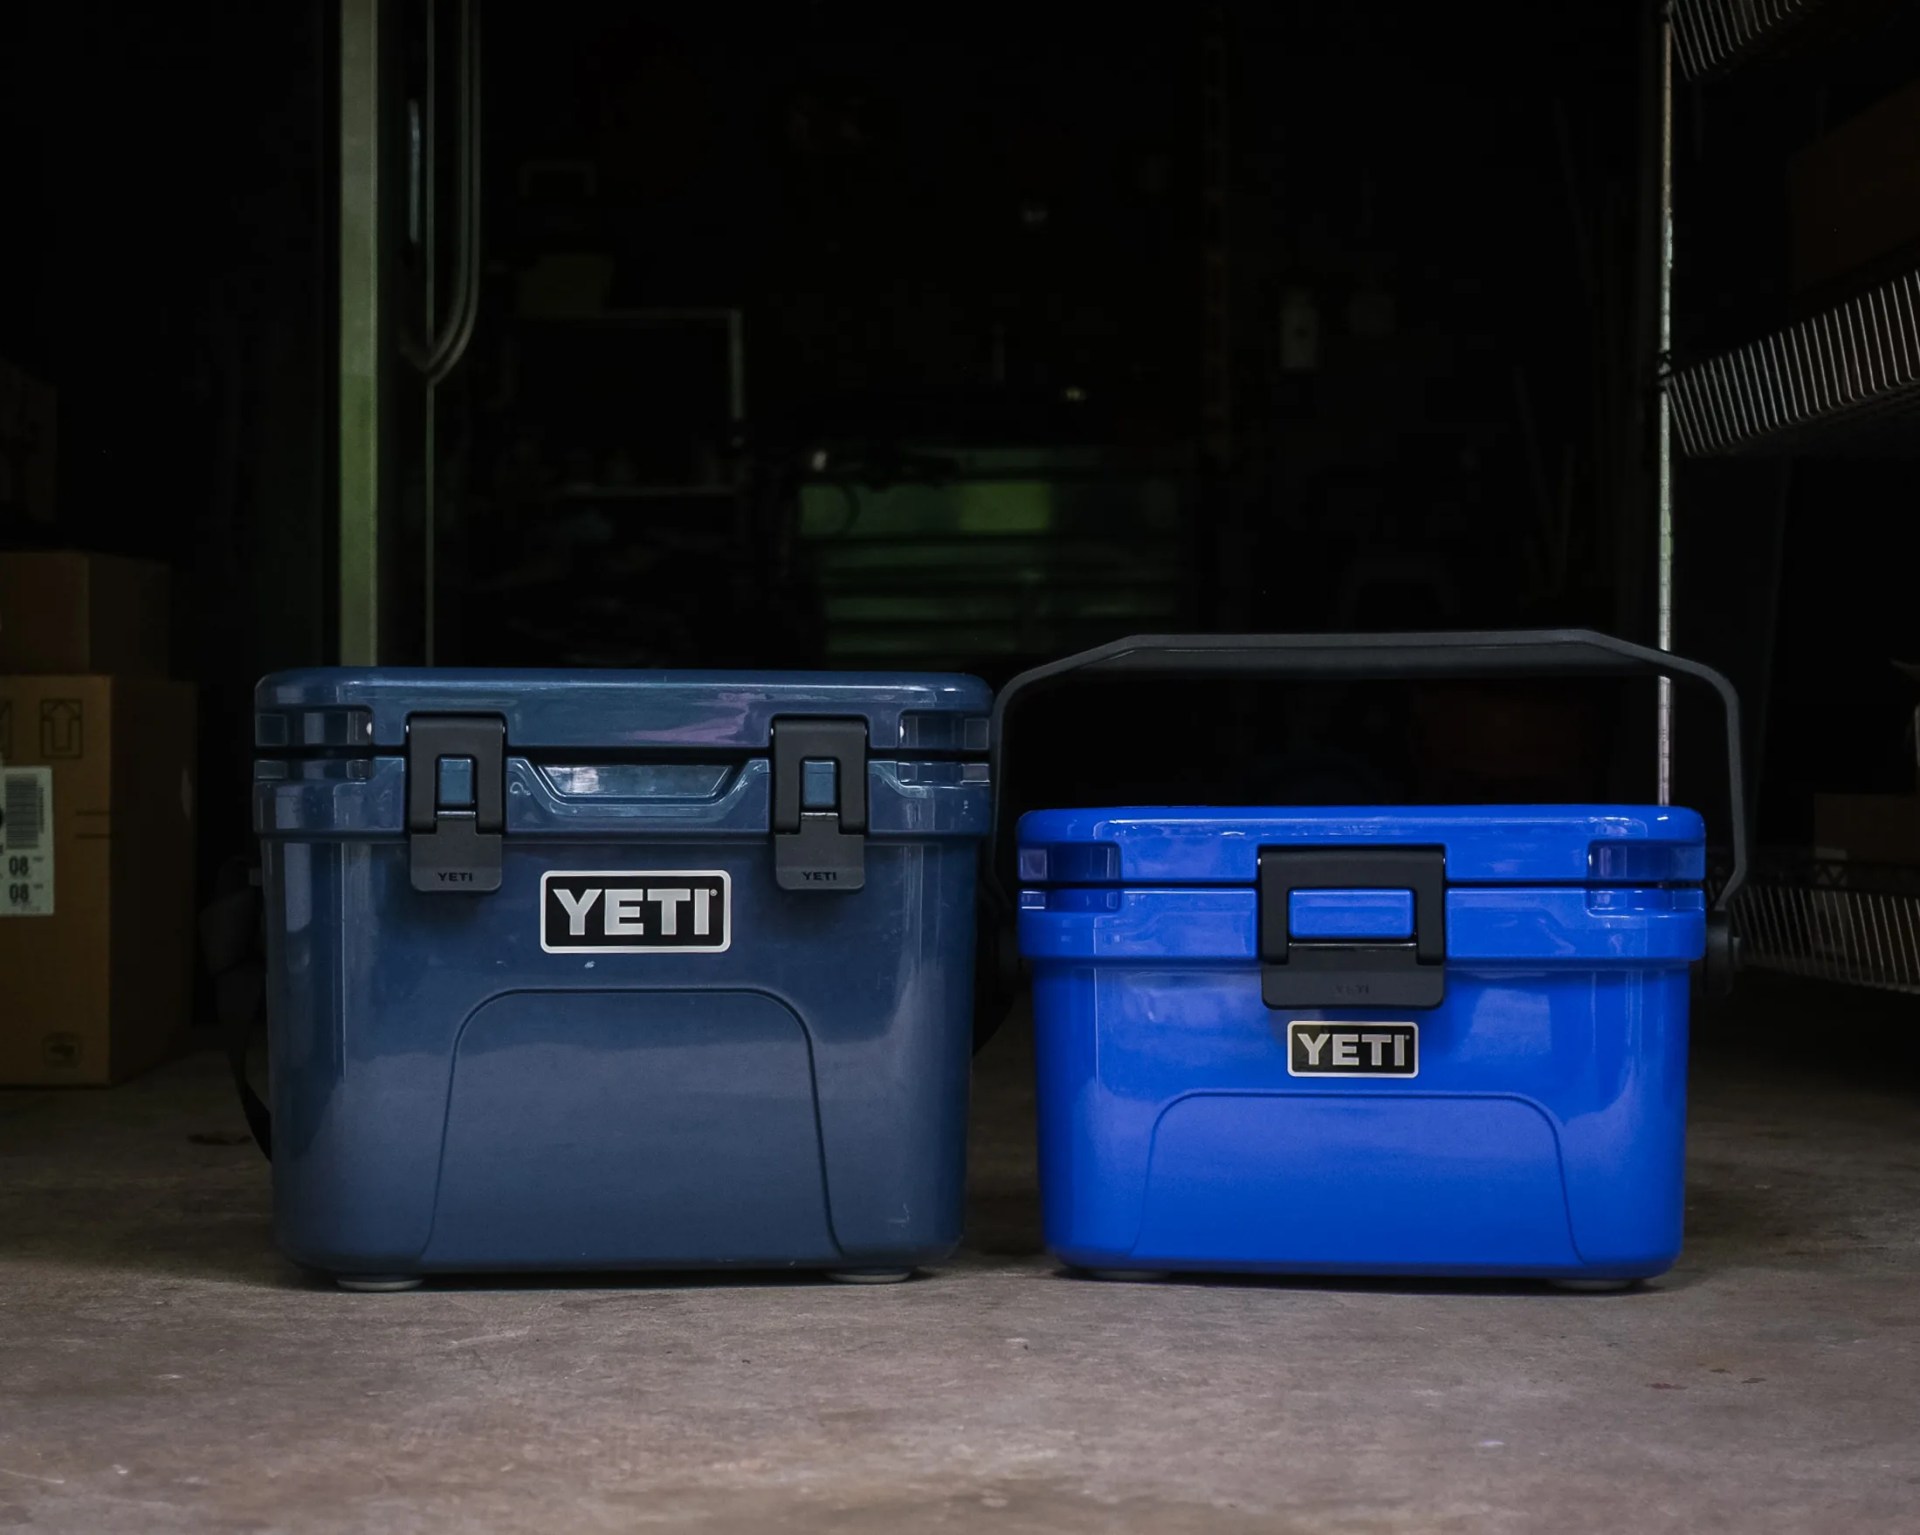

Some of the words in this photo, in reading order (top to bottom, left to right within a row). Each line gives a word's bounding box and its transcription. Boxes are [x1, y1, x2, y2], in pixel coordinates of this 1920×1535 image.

[437, 873, 473, 882] YETI
[802, 872, 837, 881] YETI
[552, 888, 717, 936] YETI
[1296, 1033, 1411, 1067] YETI
